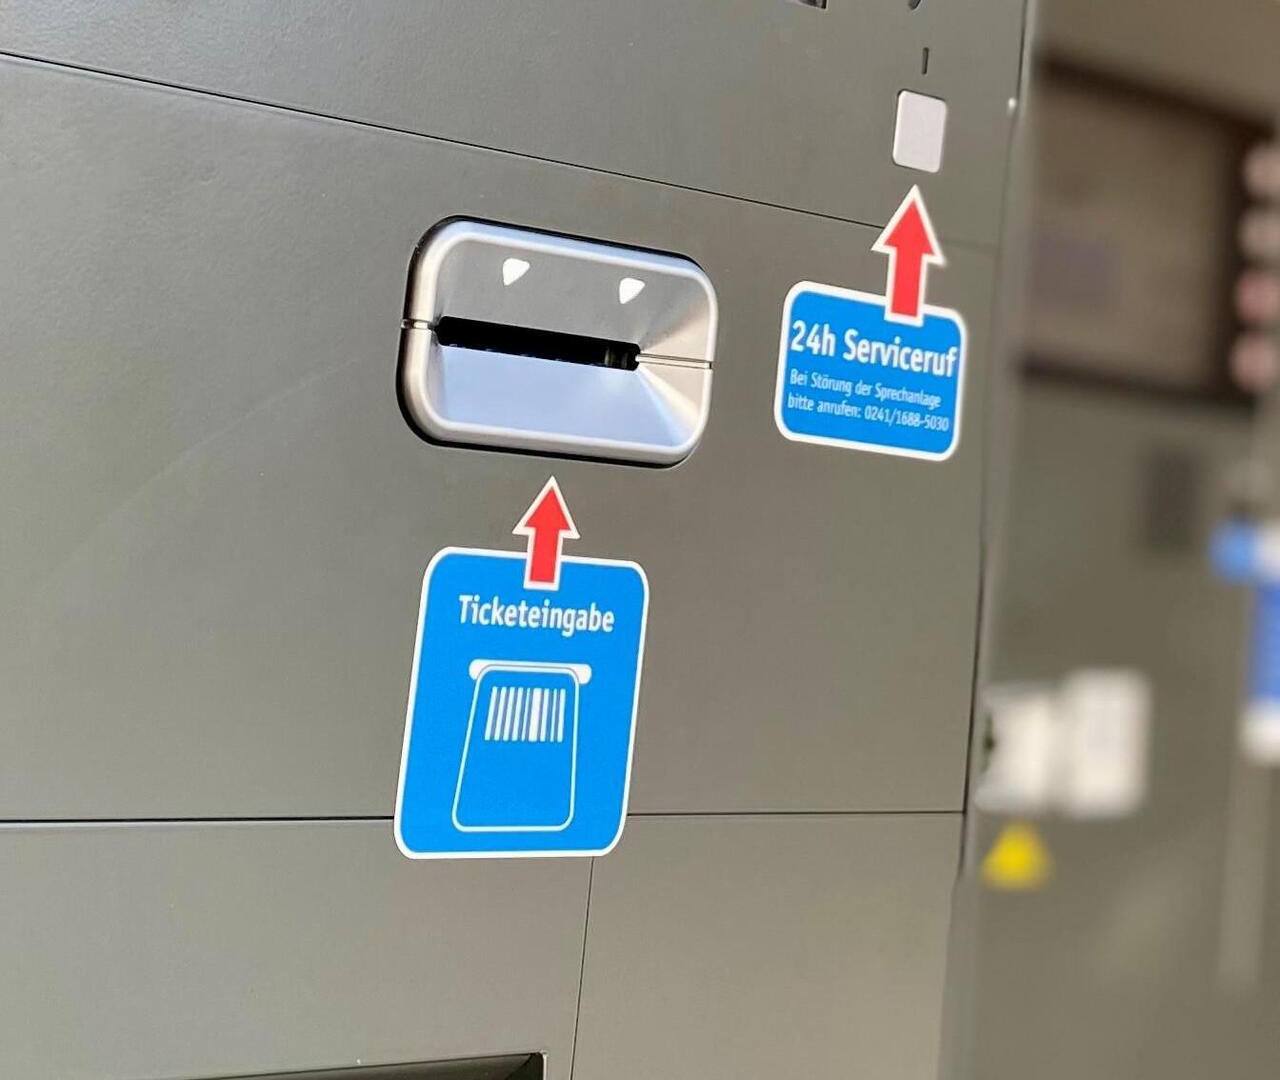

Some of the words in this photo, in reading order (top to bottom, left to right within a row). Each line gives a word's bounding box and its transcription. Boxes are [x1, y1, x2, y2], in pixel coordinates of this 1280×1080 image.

[790, 320, 836, 357] 24h
[843, 328, 958, 378] Serviceruf
[790, 368, 807, 386] Bei
[811, 371, 852, 398] Störung
[855, 379, 872, 396] der
[875, 382, 942, 410] Sprechanlage
[788, 392, 814, 410] bitte
[817, 399, 862, 419] anrufen:
[864, 405, 950, 432] 0241/1688-5030
[458, 594, 616, 638] Ticketeingabe
